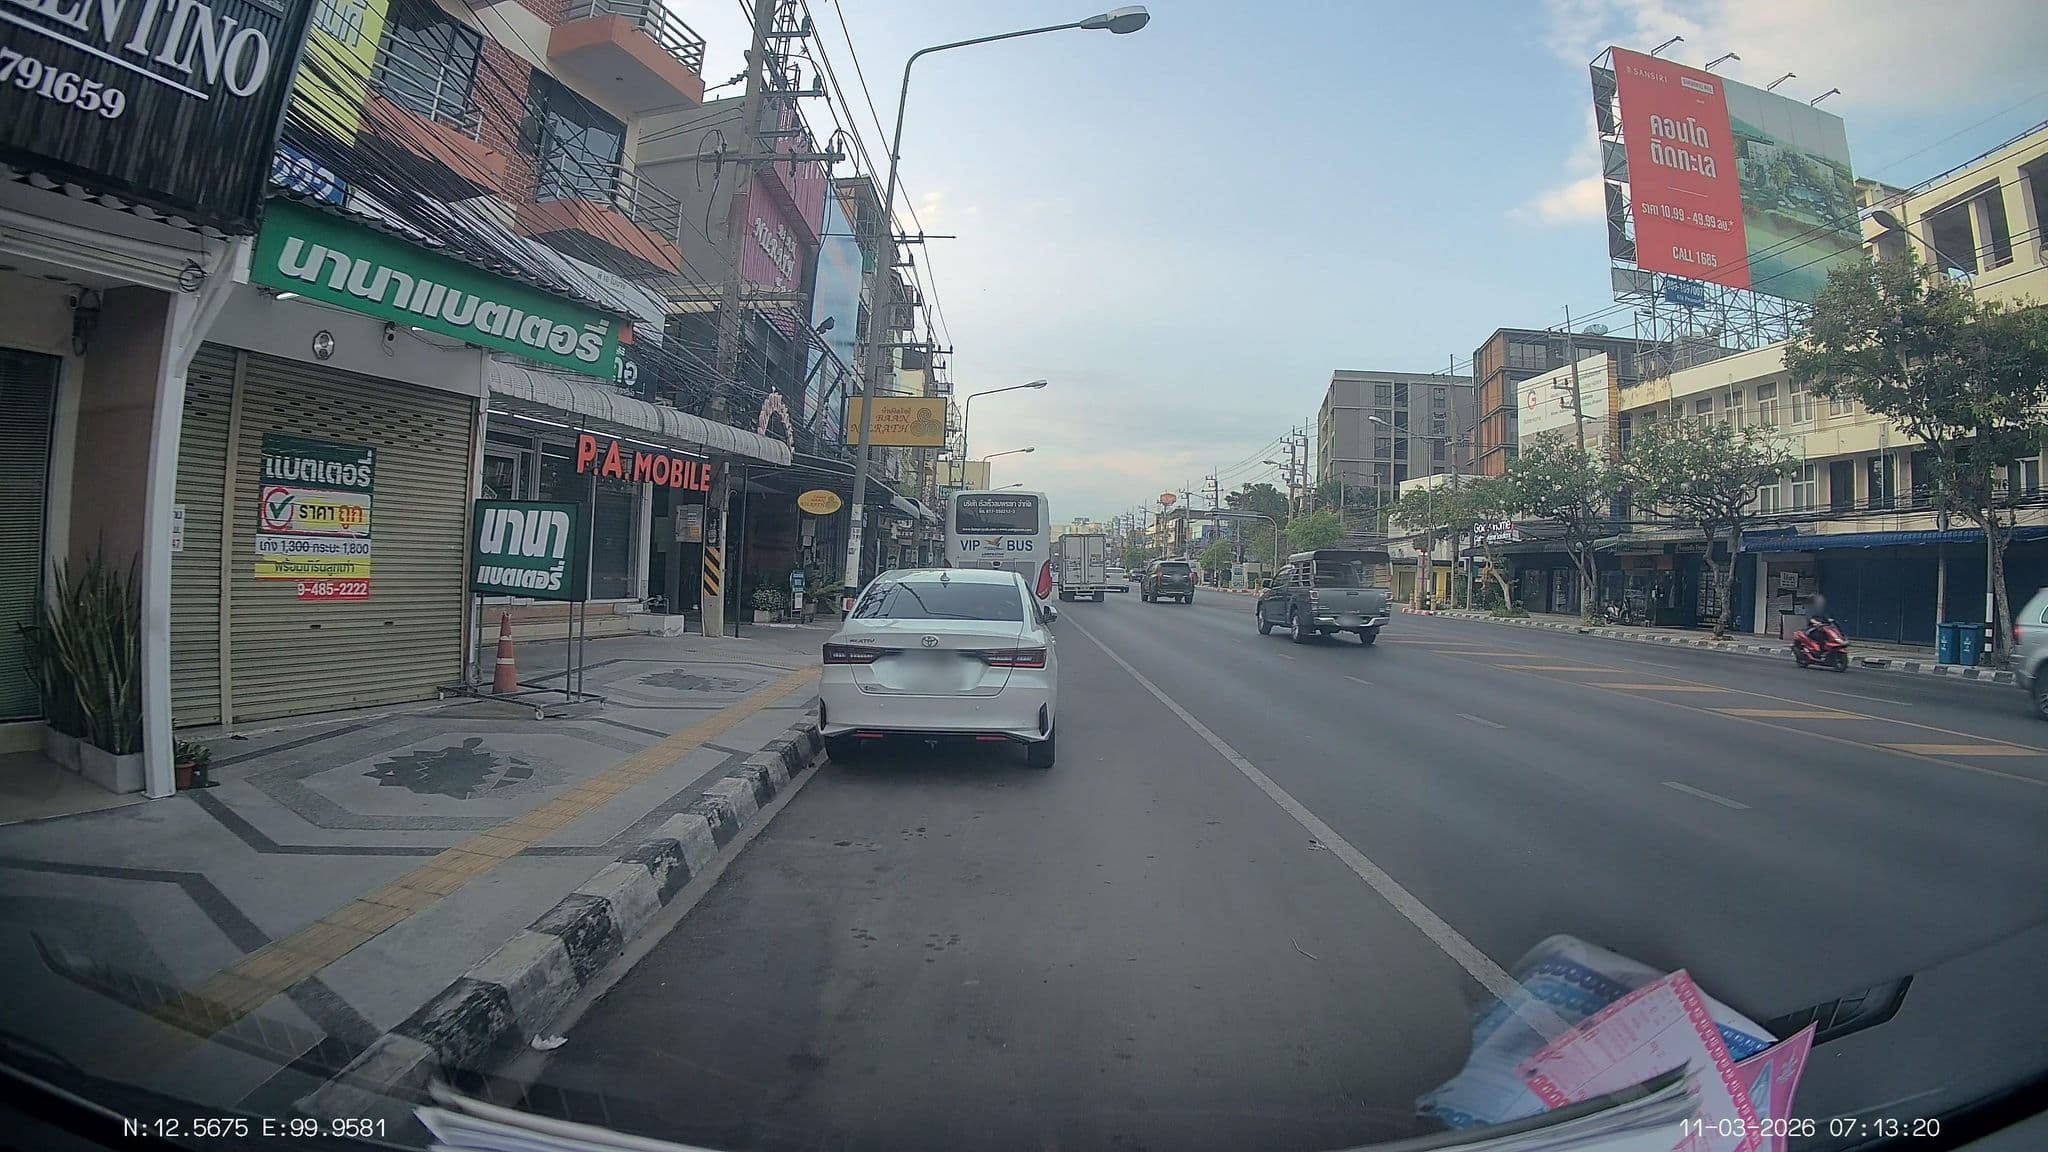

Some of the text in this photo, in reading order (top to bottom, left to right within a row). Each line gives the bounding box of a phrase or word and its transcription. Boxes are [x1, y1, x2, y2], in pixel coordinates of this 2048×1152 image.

[1633, 68, 1668, 84] SANSIRI
[1650, 114, 1710, 149] คอนโด
[1650, 138, 1717, 179] ติดทะเล
[1661, 204, 1686, 222] 10.99
[1692, 212, 1716, 229] 49.99
[1672, 246, 1718, 268] CALL 1685
[277, 235, 611, 363] นานาแบตเตอรี่
[265, 450, 372, 487] แบตเตอรี่
[299, 504, 363, 530] ราคา ถูก
[479, 508, 570, 559] นานา
[960, 540, 1033, 551] VIP BUS
[281, 540, 310, 554] 1,300
[342, 543, 369, 556] 1,800
[476, 560, 566, 591] แบตเตอรี่
